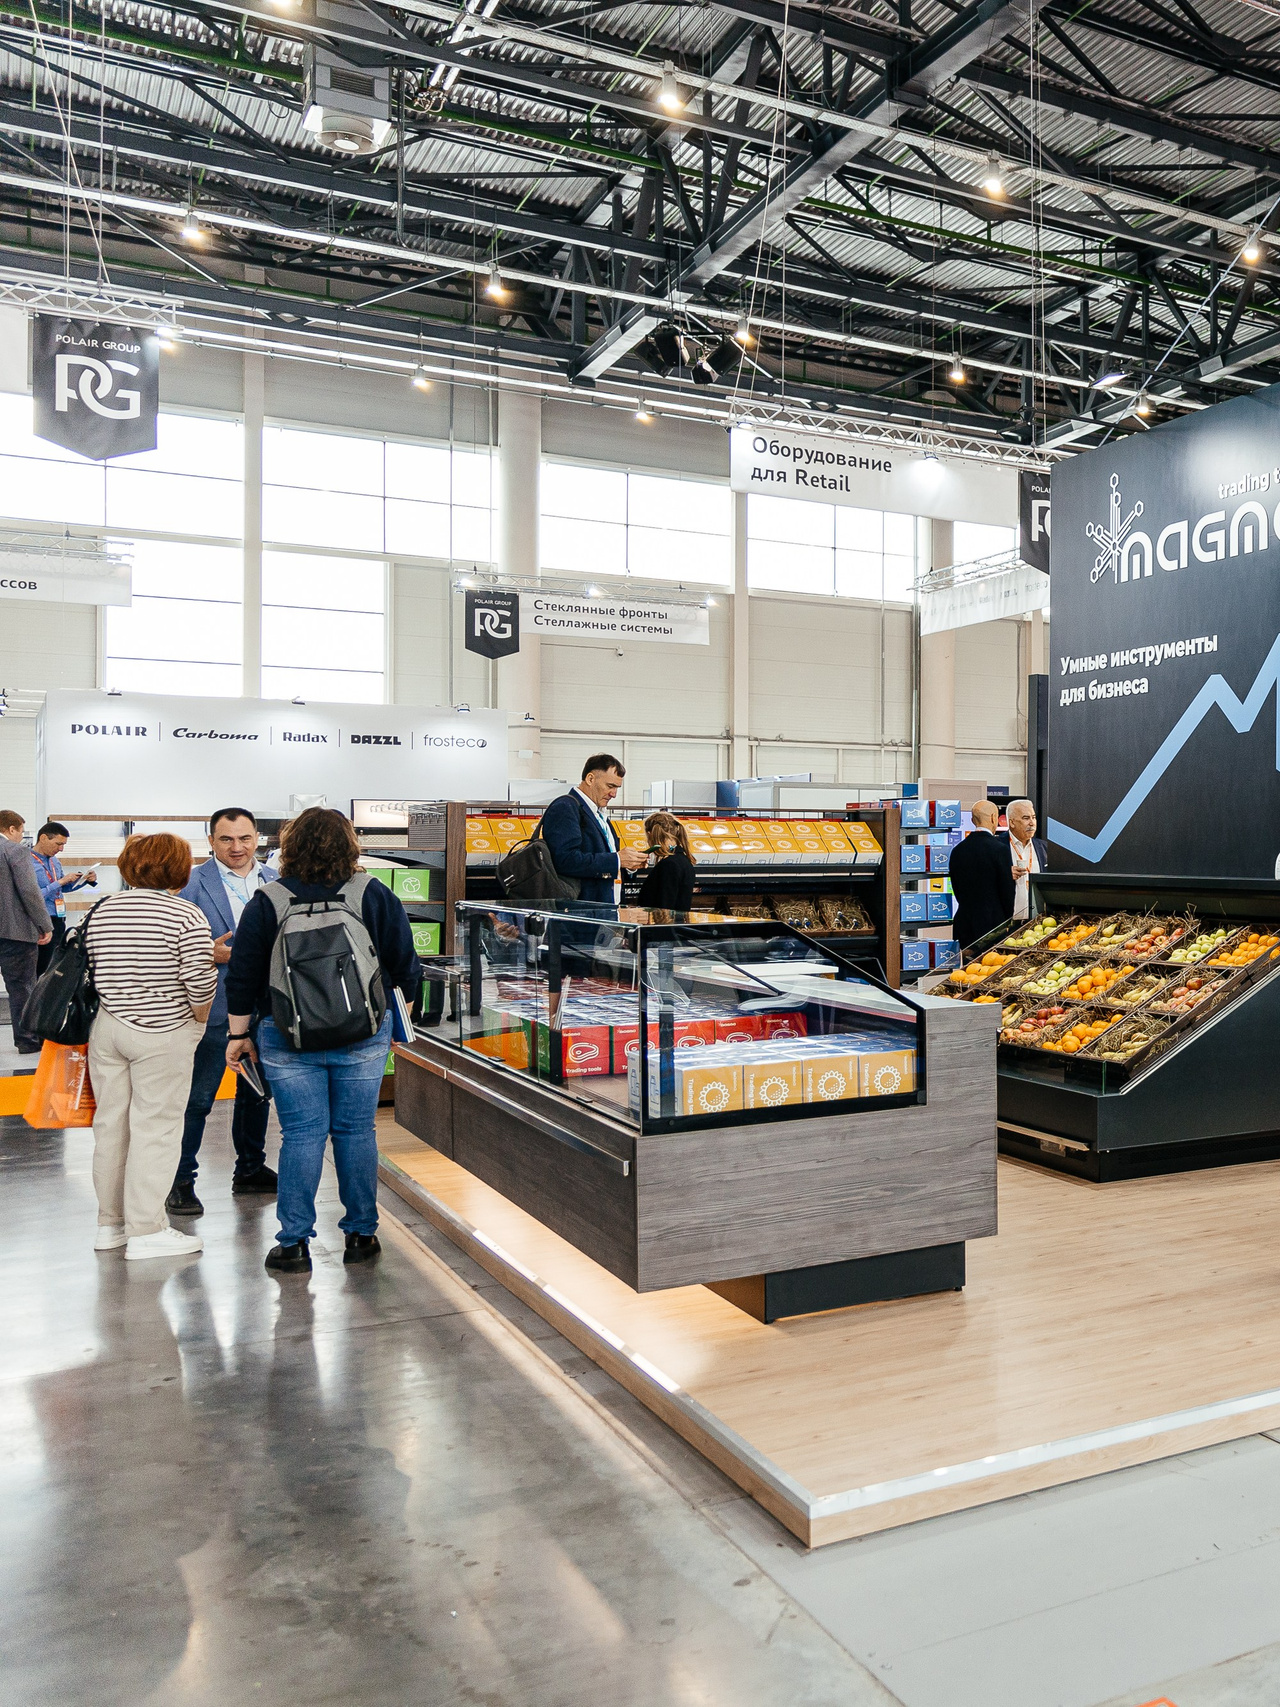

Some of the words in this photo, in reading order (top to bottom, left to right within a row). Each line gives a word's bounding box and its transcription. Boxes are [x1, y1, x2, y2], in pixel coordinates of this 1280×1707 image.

[55, 334, 99, 348] POLAIR
[102, 340, 141, 354] GROUP
[752, 436, 892, 473] Оборудование
[751, 466, 787, 483] для
[795, 468, 851, 492] Retail
[1217, 473, 1271, 500] trading
[474, 598, 494, 606] POLAIR
[494, 599, 512, 607] GROUP
[533, 599, 616, 616] Стеклянные
[619, 606, 669, 621] фронты
[533, 615, 617, 631] Стеллажные
[620, 621, 673, 635] системы
[1060, 653, 1108, 676] Умные
[1110, 634, 1219, 668] инструменты
[1059, 684, 1087, 707] для
[1088, 677, 1149, 701] бизнеса
[71, 723, 148, 737] POLAIR
[172, 727, 259, 741] Carboma
[282, 731, 328, 744] Radax
[350, 734, 402, 746] DAZZL
[423, 733, 488, 749] frosteco
